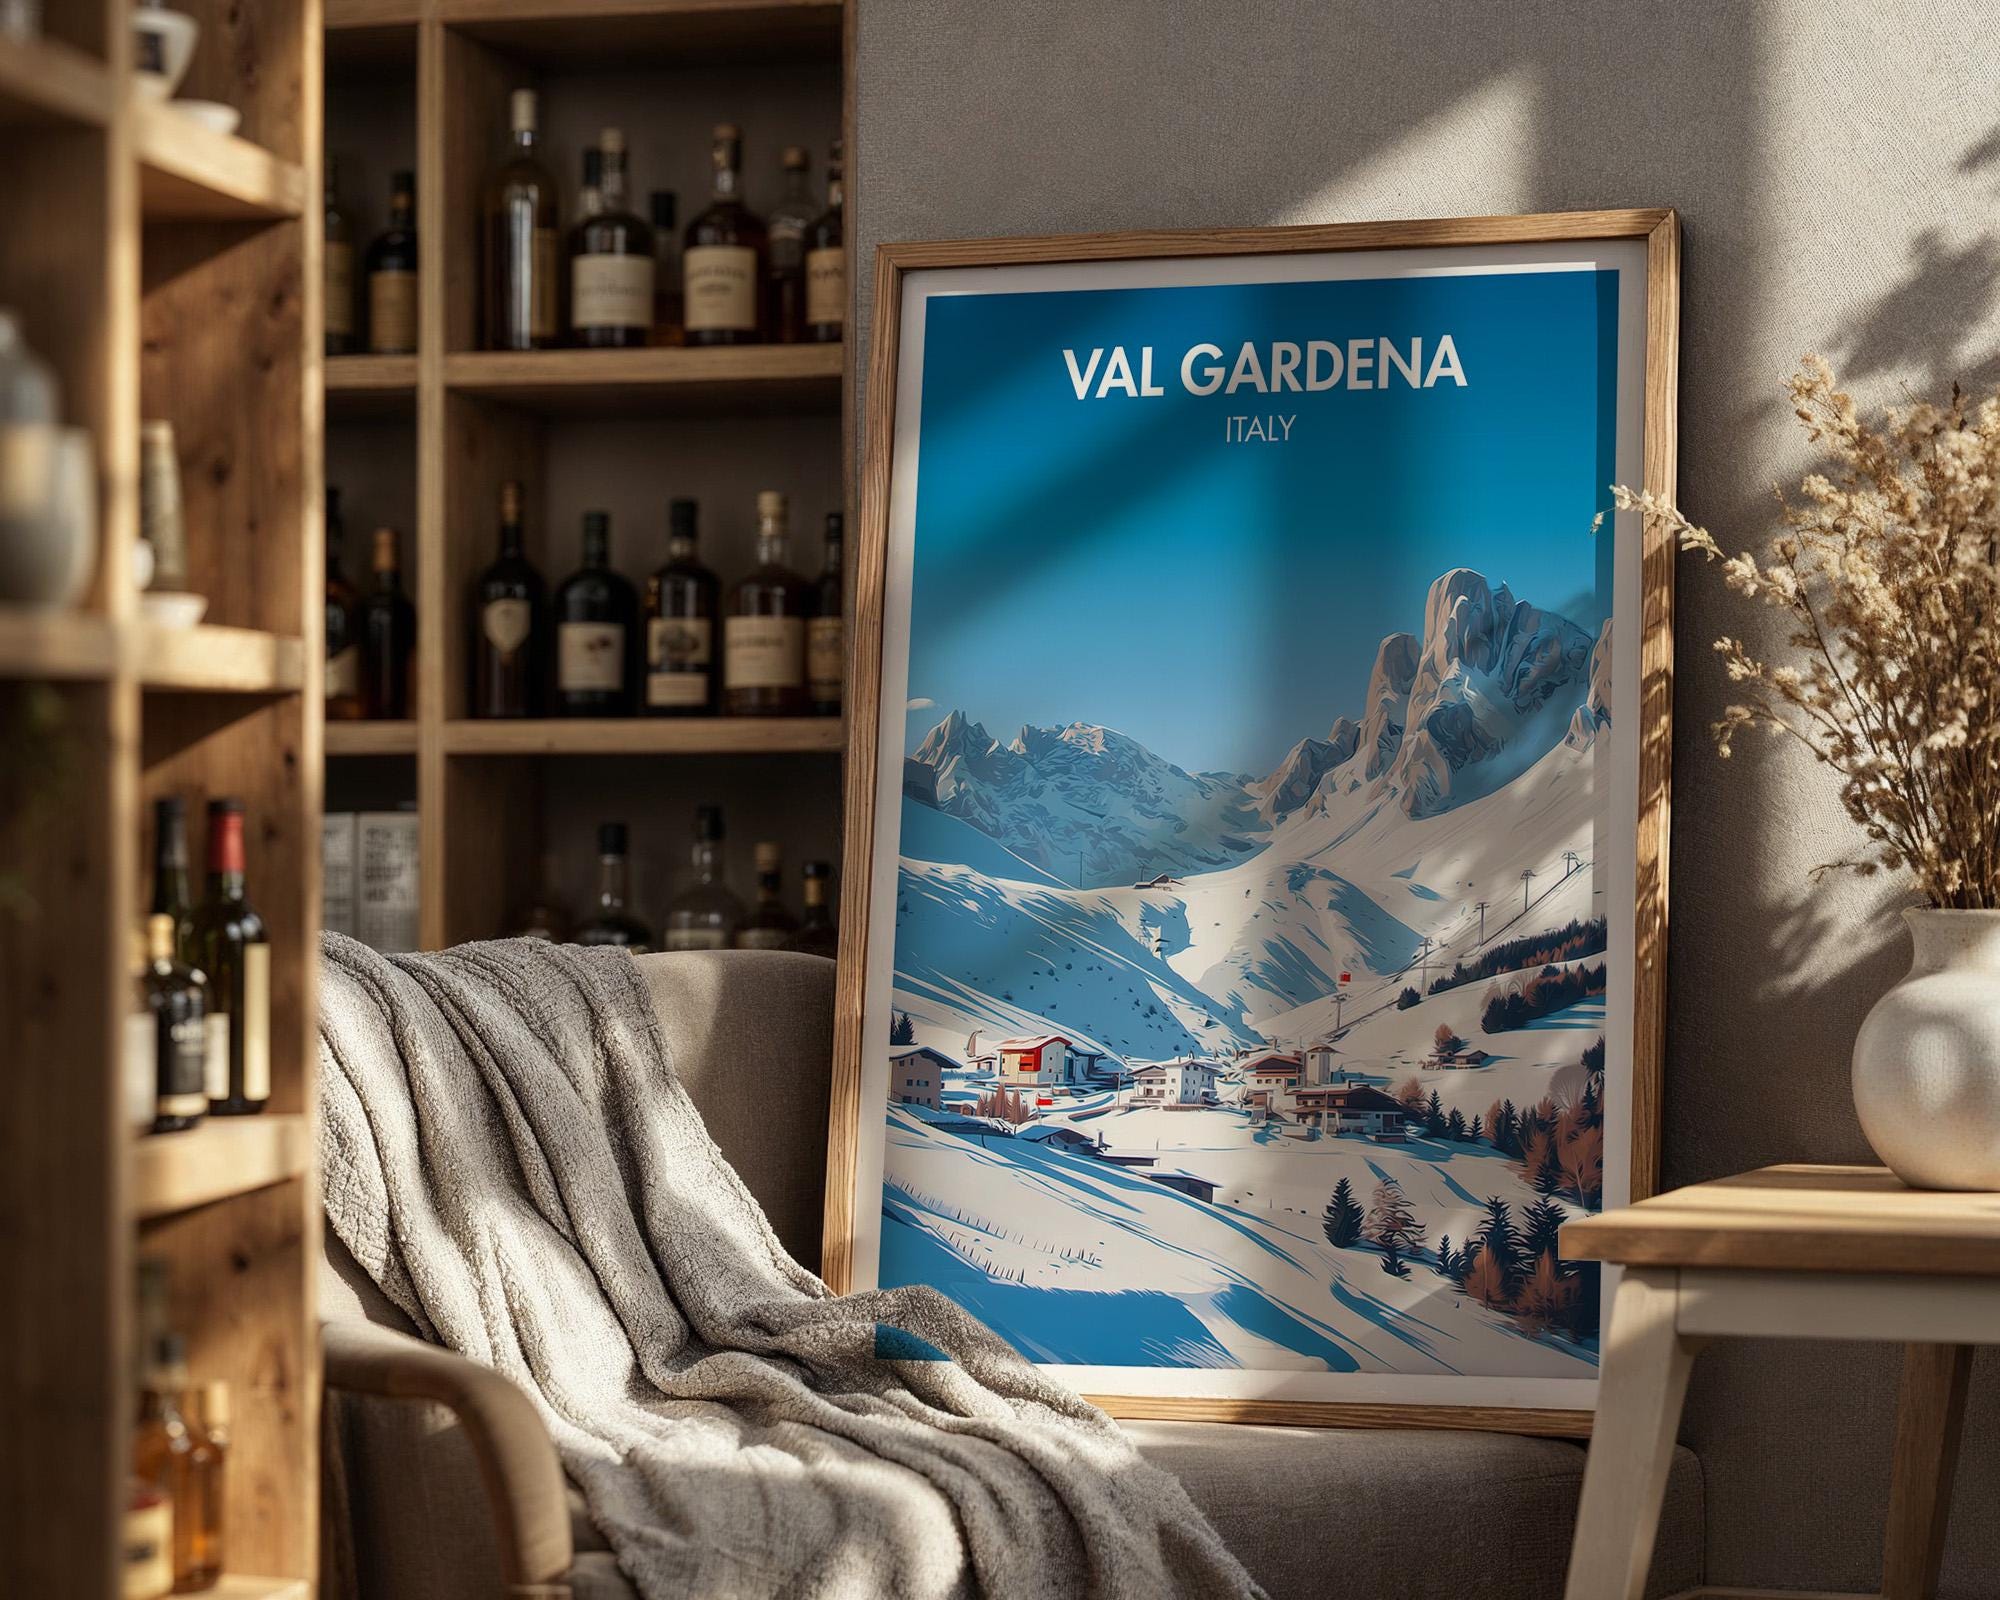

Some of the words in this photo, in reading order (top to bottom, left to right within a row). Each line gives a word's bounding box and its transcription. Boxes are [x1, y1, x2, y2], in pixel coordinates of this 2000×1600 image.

[1062, 346, 1165, 400] VAL
[1180, 334, 1469, 396] GARDENA
[1226, 414, 1297, 443] ITALY
